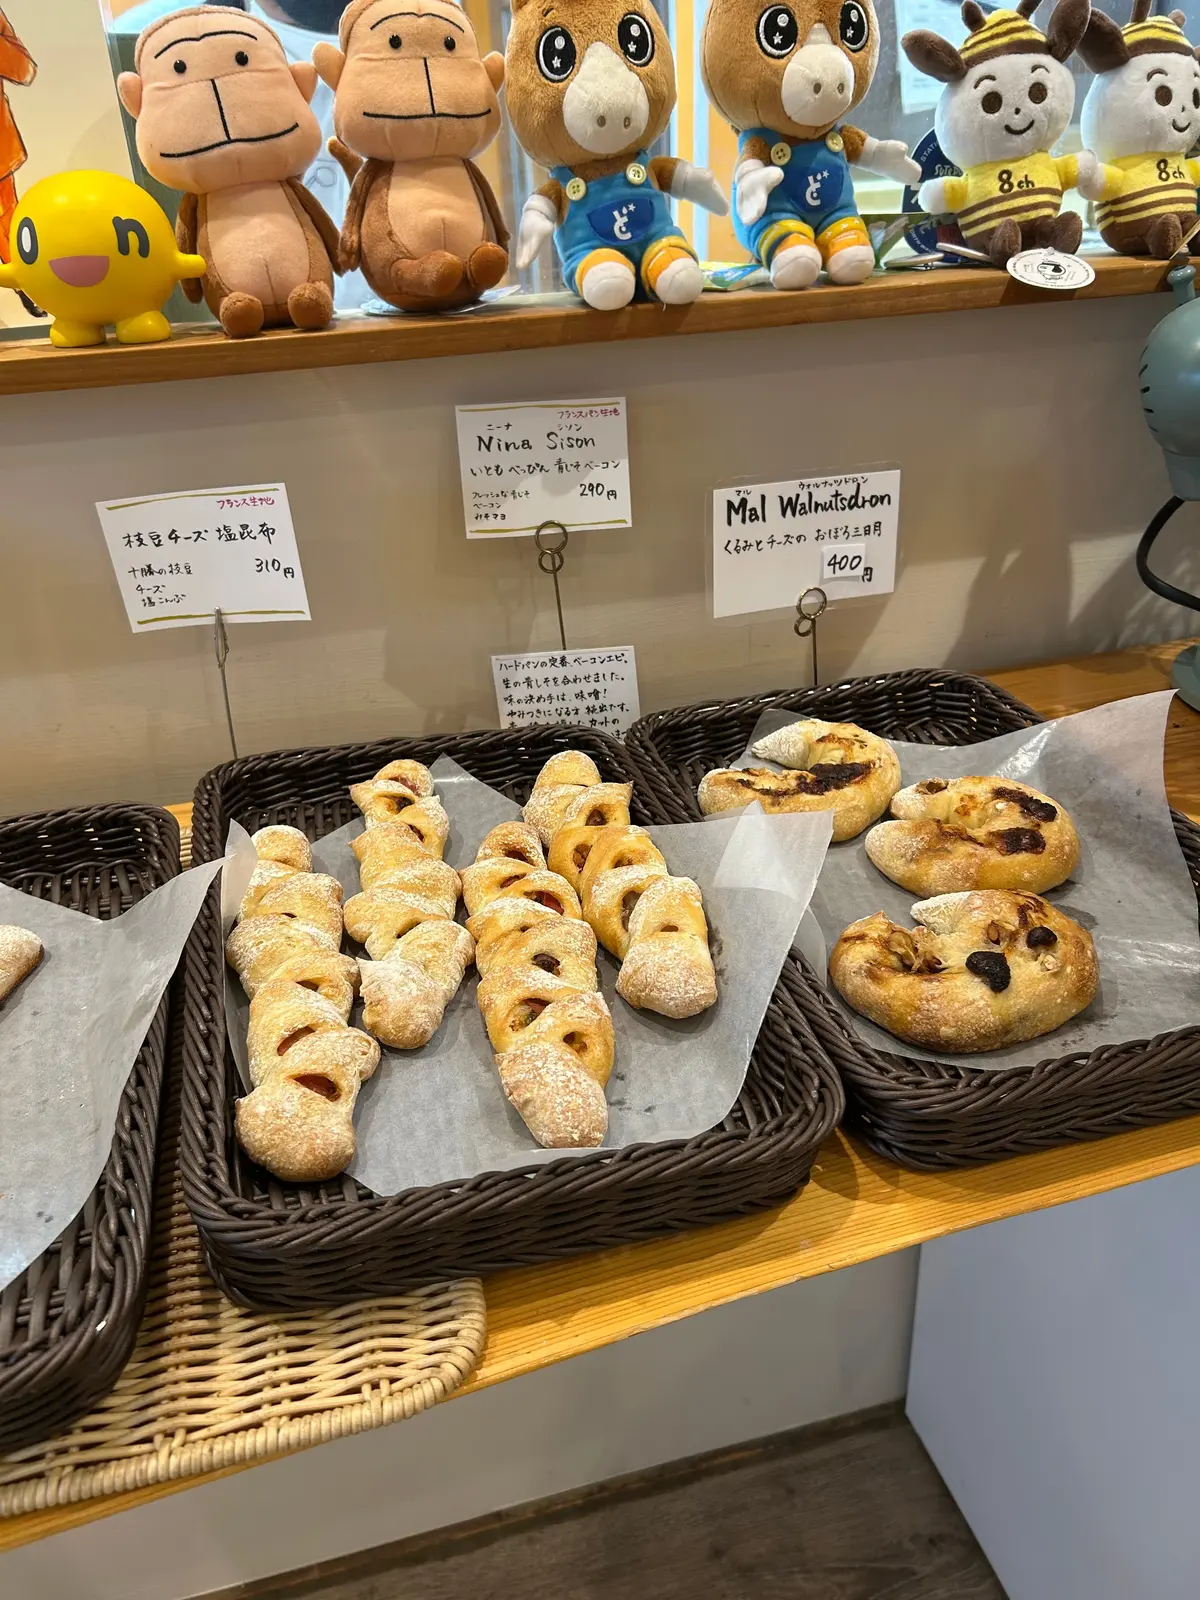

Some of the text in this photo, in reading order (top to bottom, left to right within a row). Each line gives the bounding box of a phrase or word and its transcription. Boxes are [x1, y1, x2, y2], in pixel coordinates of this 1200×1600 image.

[557, 408, 620, 419] フランスパン生地
[486, 422, 513, 431] ニーナ
[557, 423, 583, 432] シソン
[476, 431, 596, 452] Nina Sison
[216, 496, 275, 510] フランス生地
[472, 502, 502, 510] ベーコン
[726, 482, 892, 527] Mal Walnutsdron
[255, 558, 295, 579] 310円
[135, 584, 166, 594] チーズ
